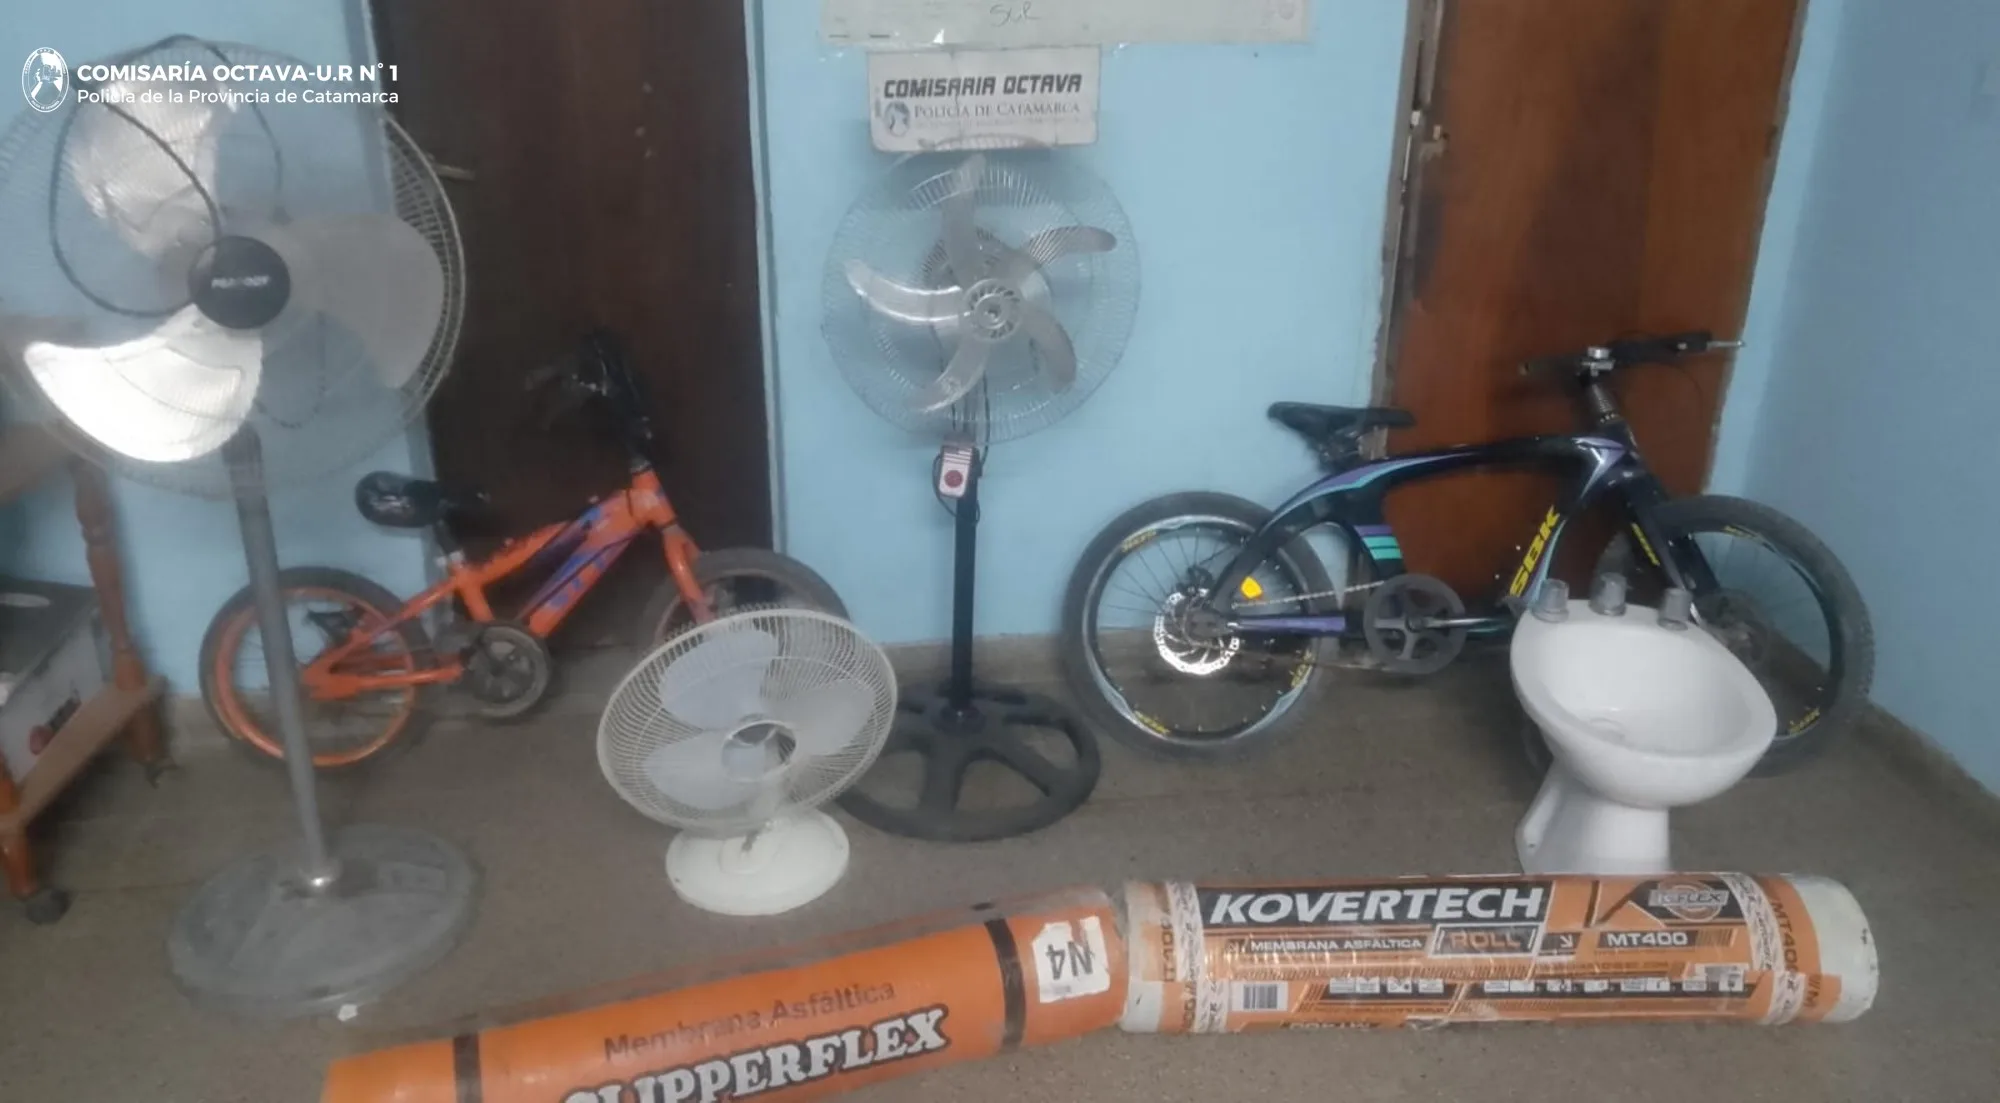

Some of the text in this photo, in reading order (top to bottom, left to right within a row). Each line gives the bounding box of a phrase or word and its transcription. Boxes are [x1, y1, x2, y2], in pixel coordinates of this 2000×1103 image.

[884, 73, 1083, 98] COMISARIA OCTAVA
[1509, 504, 1561, 598] SBK
[1209, 887, 1543, 924] KOVERTECH
[1249, 939, 1339, 952] MEMBRANA
[1607, 931, 1689, 947] MT400
[604, 980, 896, 1061] Membrana Asfáltica
